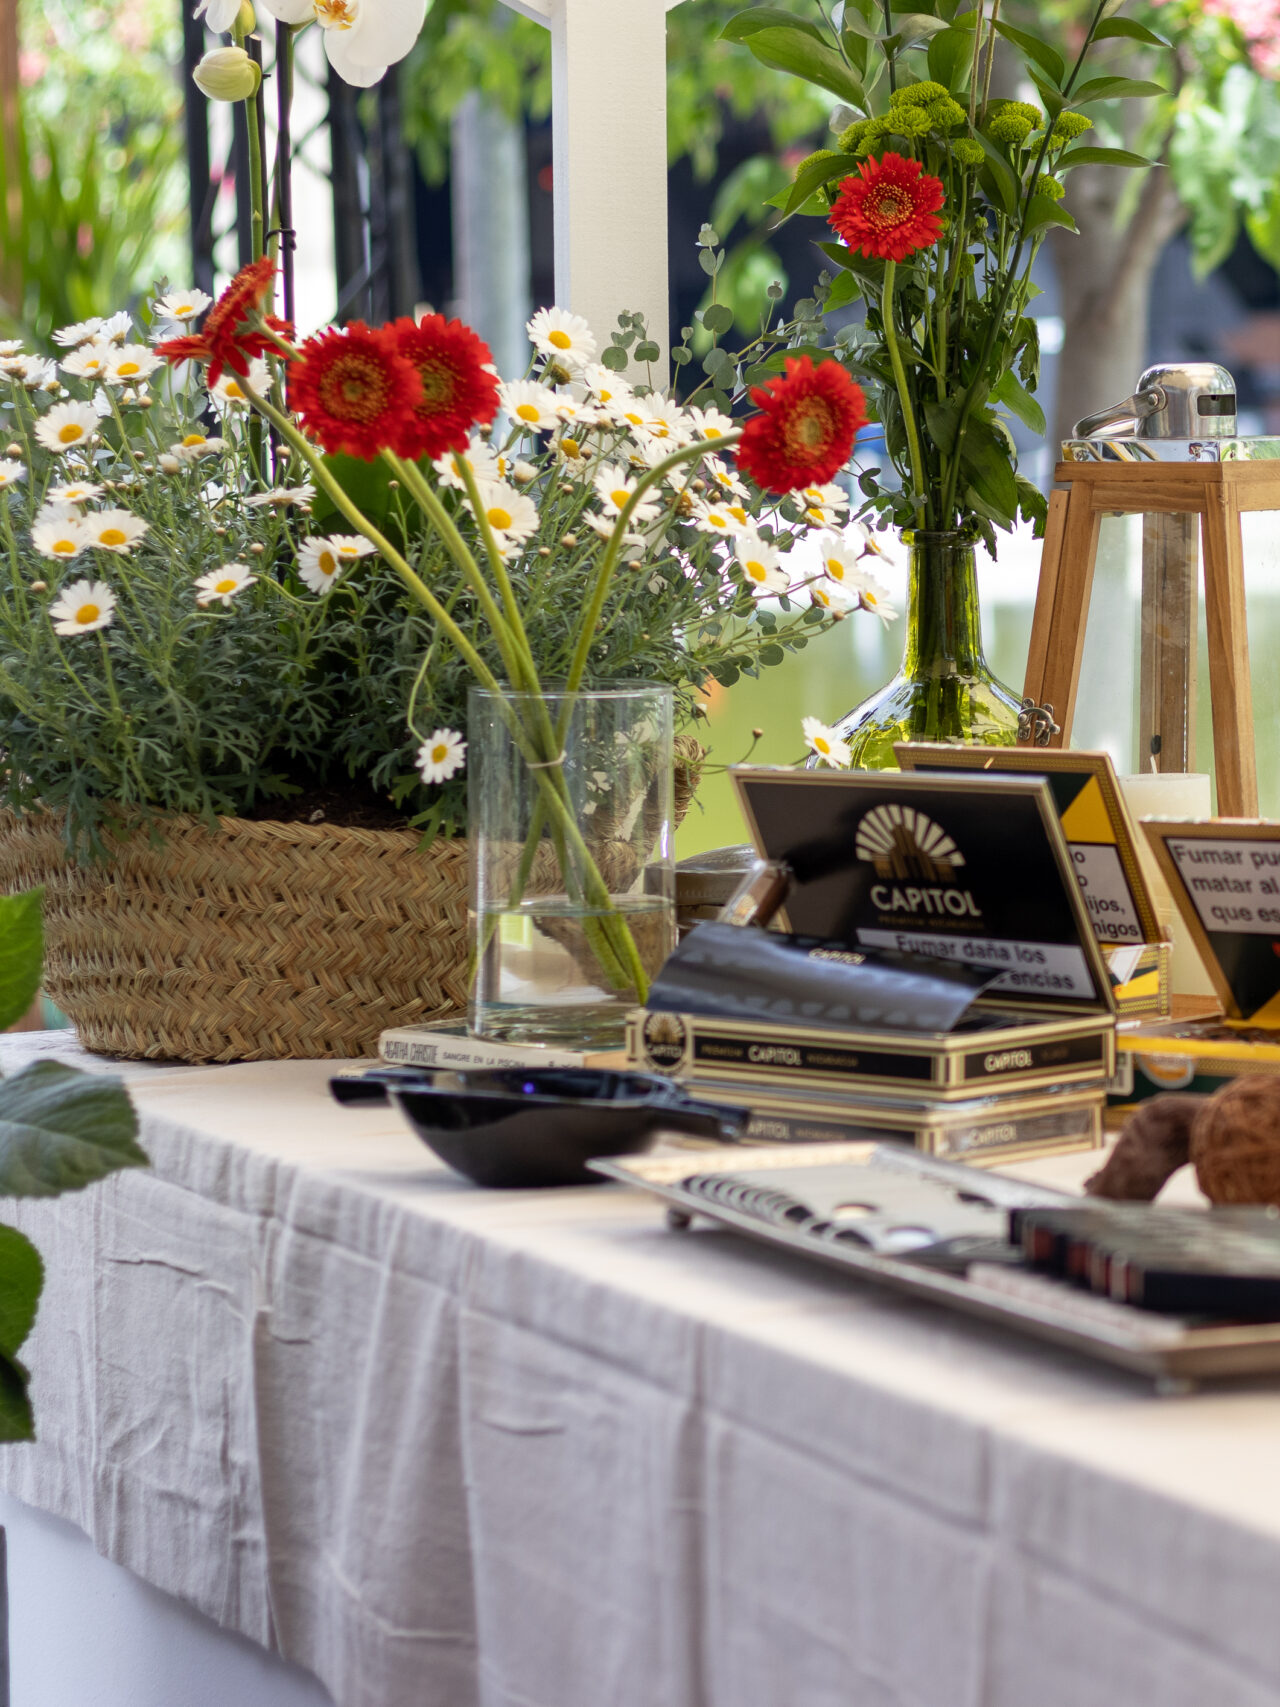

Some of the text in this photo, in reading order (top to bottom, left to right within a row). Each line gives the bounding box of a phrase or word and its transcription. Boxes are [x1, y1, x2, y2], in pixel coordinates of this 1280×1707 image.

[1173, 845, 1242, 865] Fumar
[1191, 876, 1252, 894] matar
[1259, 876, 1280, 895] al
[870, 885, 982, 917] CAPITOL
[1087, 895, 1126, 915] ijos,
[1211, 905, 1252, 925] que
[808, 947, 866, 965] CAPITOL
[896, 934, 1046, 964] Fumar daña los
[384, 1041, 408, 1059] AGATHA
[410, 1043, 438, 1064] CHRISTIE
[443, 1052, 470, 1063] SANGRE
[474, 1056, 484, 1064] EN
[748, 1045, 802, 1066] CAPITOL
[984, 1049, 1033, 1072] CAPITOL
[746, 1119, 790, 1140] APITOL
[968, 1123, 1016, 1146] CAPITOL
